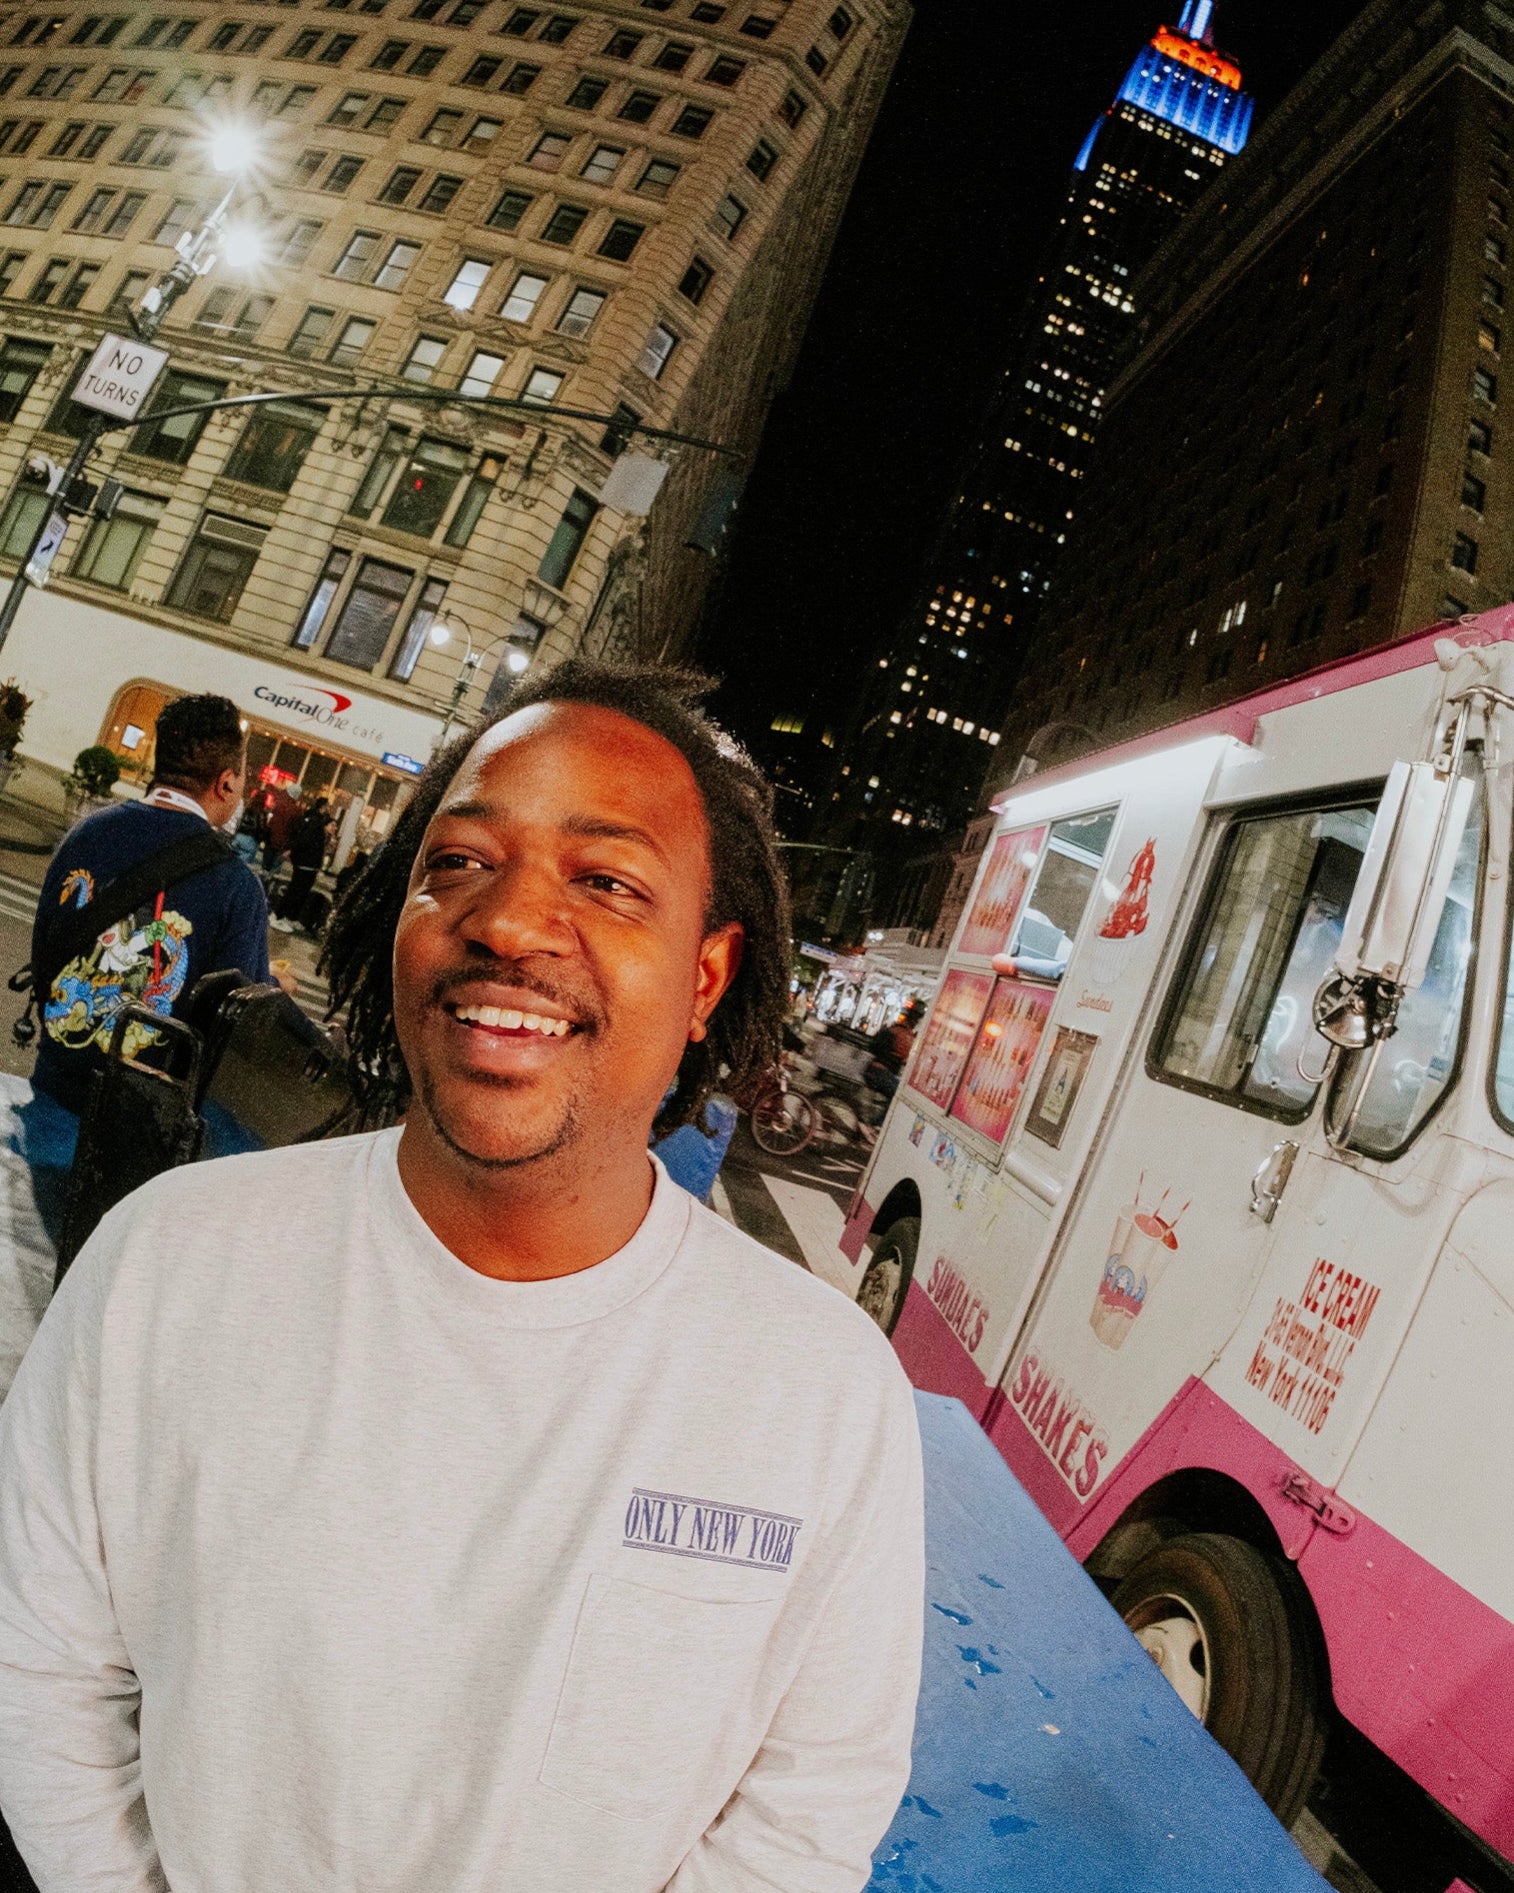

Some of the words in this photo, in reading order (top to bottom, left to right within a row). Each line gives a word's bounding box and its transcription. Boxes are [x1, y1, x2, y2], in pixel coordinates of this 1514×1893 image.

[84, 374, 140, 406] TURNS
[109, 349, 143, 375] NO
[927, 1255, 990, 1353] SUNDAES
[1299, 1257, 1335, 1314] ICE
[1322, 1269, 1381, 1341] CREAM
[1244, 1340, 1275, 1392] New
[1268, 1355, 1300, 1411] York
[1012, 1353, 1109, 1497] SHAKES
[624, 1495, 687, 1546] ONLY
[687, 1505, 747, 1555] NEW
[748, 1516, 802, 1565] YORK
